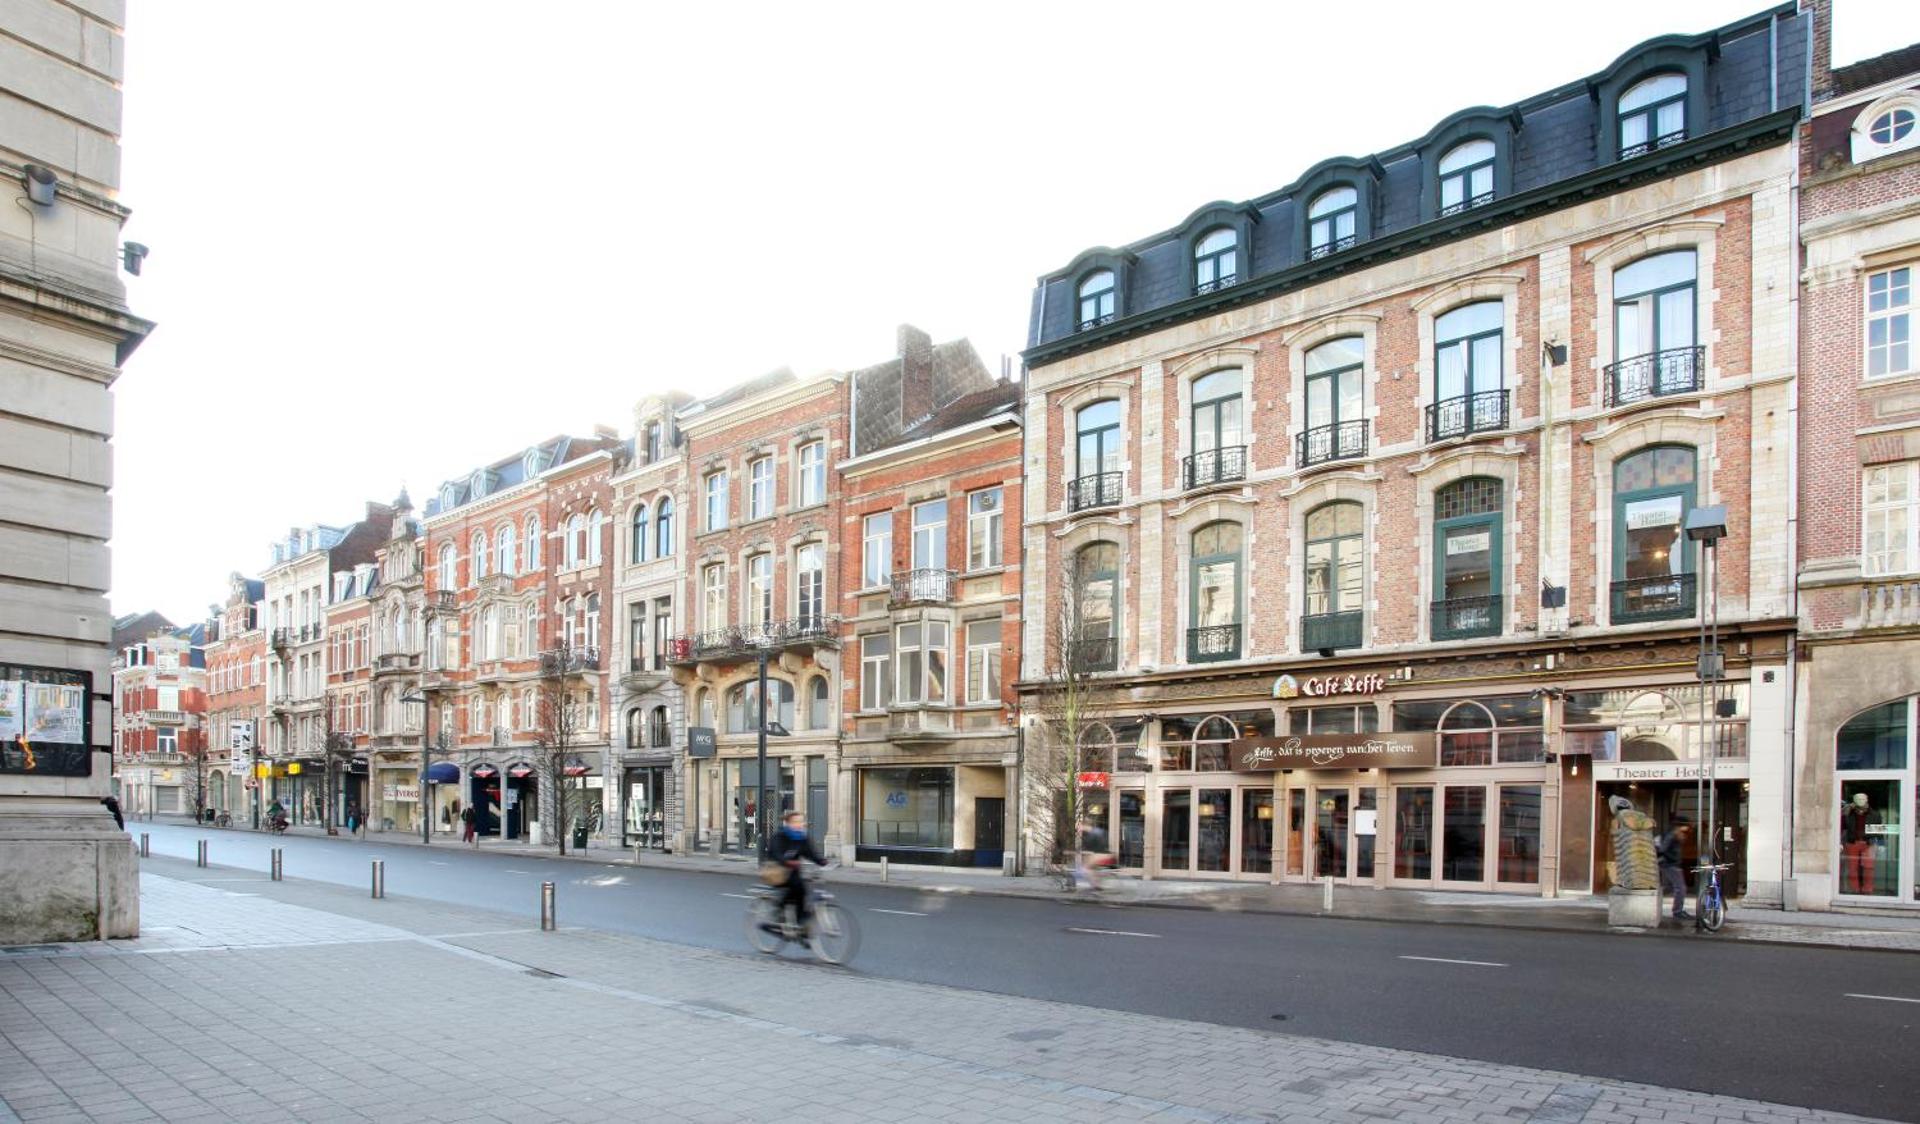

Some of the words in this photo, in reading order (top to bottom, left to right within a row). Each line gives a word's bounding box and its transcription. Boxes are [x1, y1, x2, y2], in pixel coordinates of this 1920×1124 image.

[1302, 677, 1339, 697] Café
[1341, 673, 1385, 695] Leffe
[1295, 748, 1303, 756] is
[1613, 767, 1667, 779] Theater
[1675, 766, 1712, 778] Hotel
